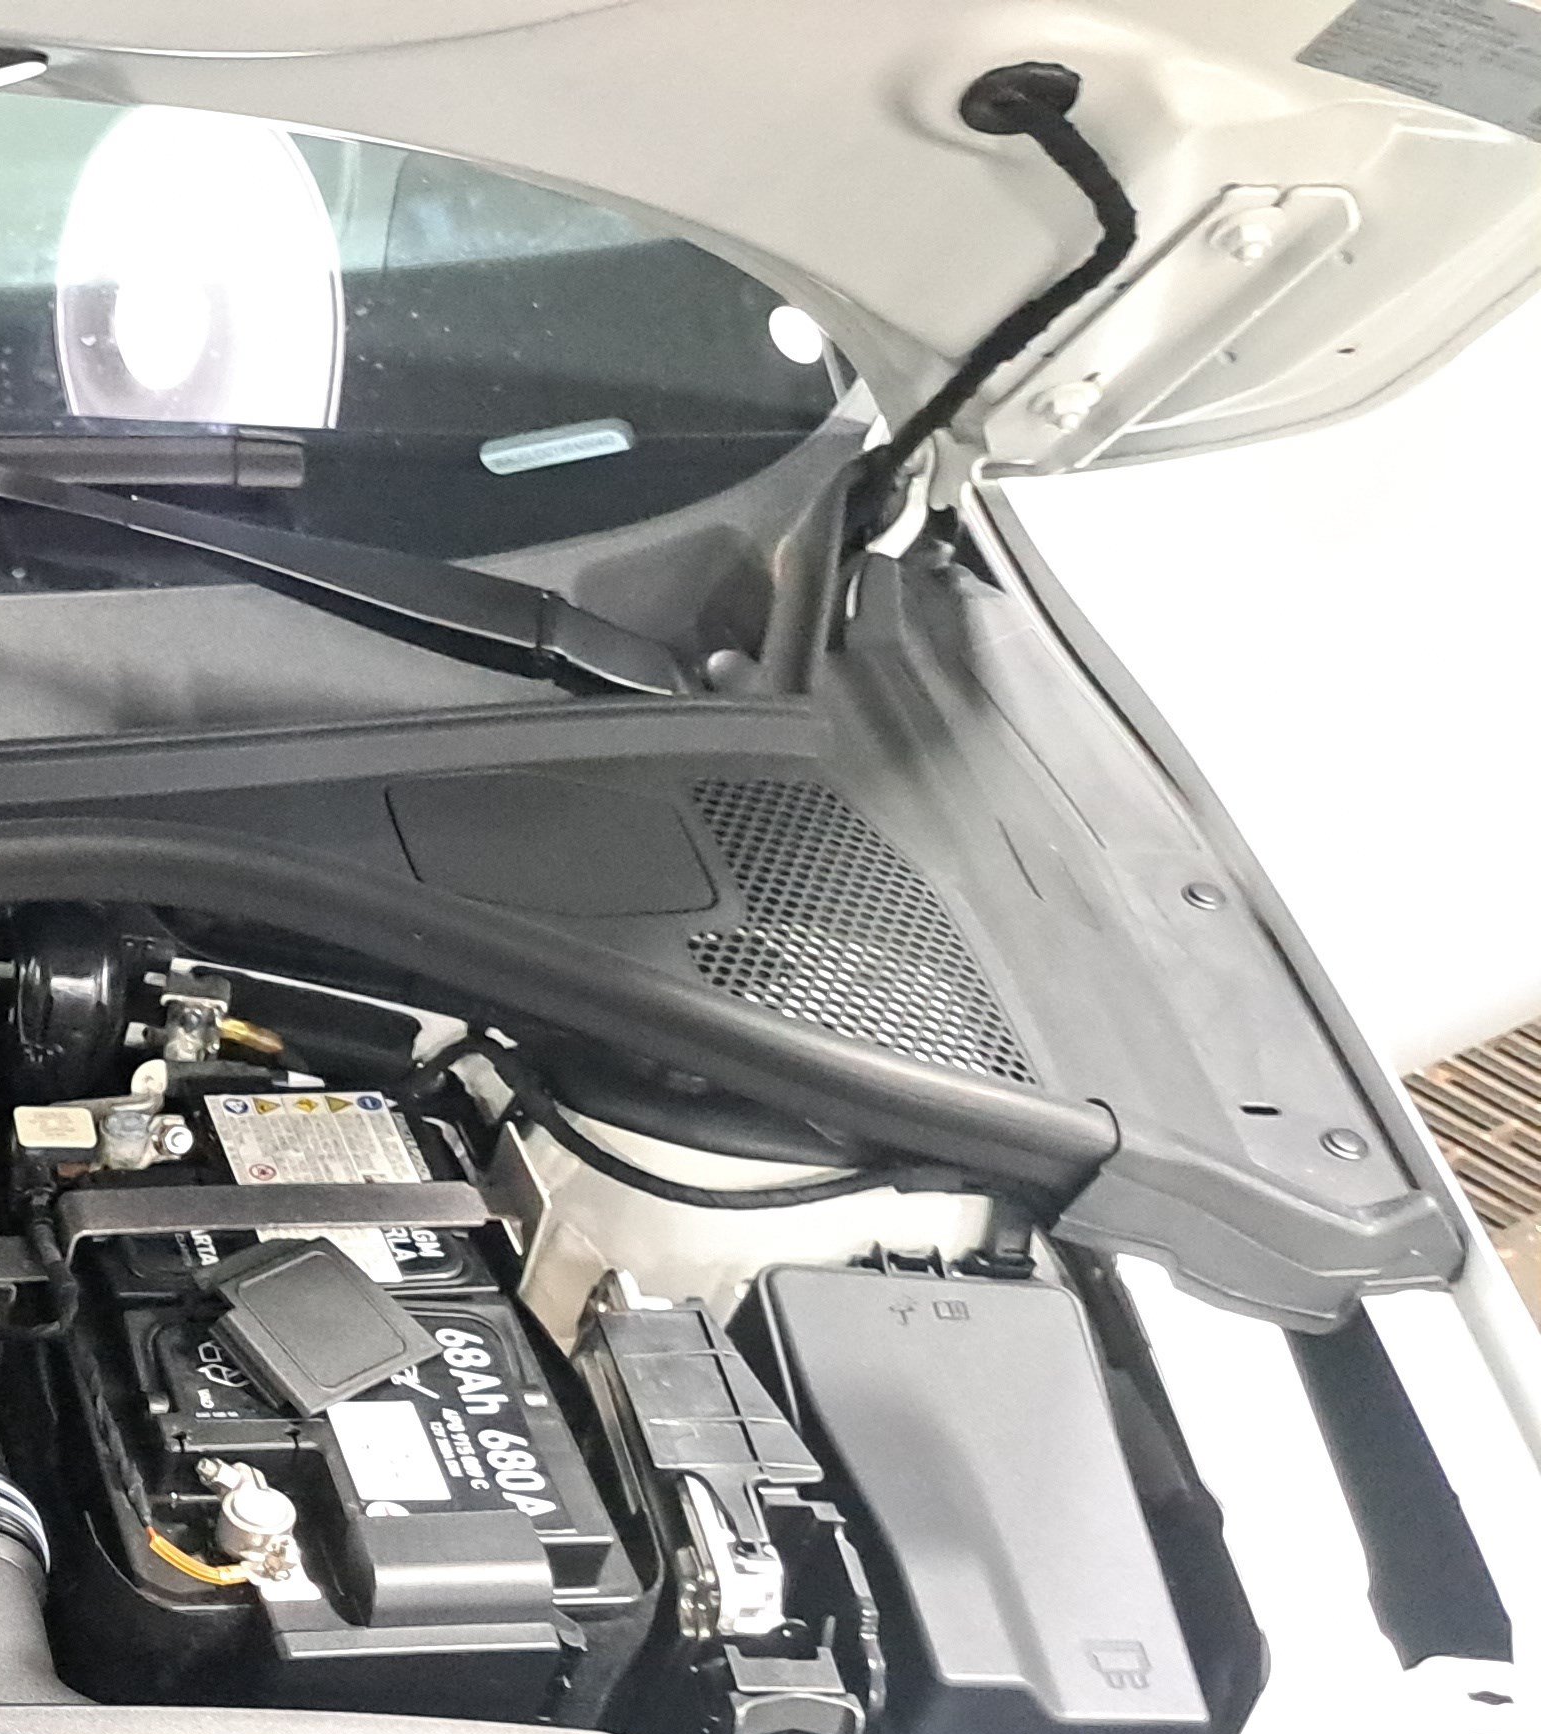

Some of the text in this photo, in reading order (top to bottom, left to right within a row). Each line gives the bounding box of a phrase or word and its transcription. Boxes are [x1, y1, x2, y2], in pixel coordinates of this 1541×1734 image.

[411, 1227, 445, 1257] GM
[435, 1328, 557, 1517] 68Ah 680A
